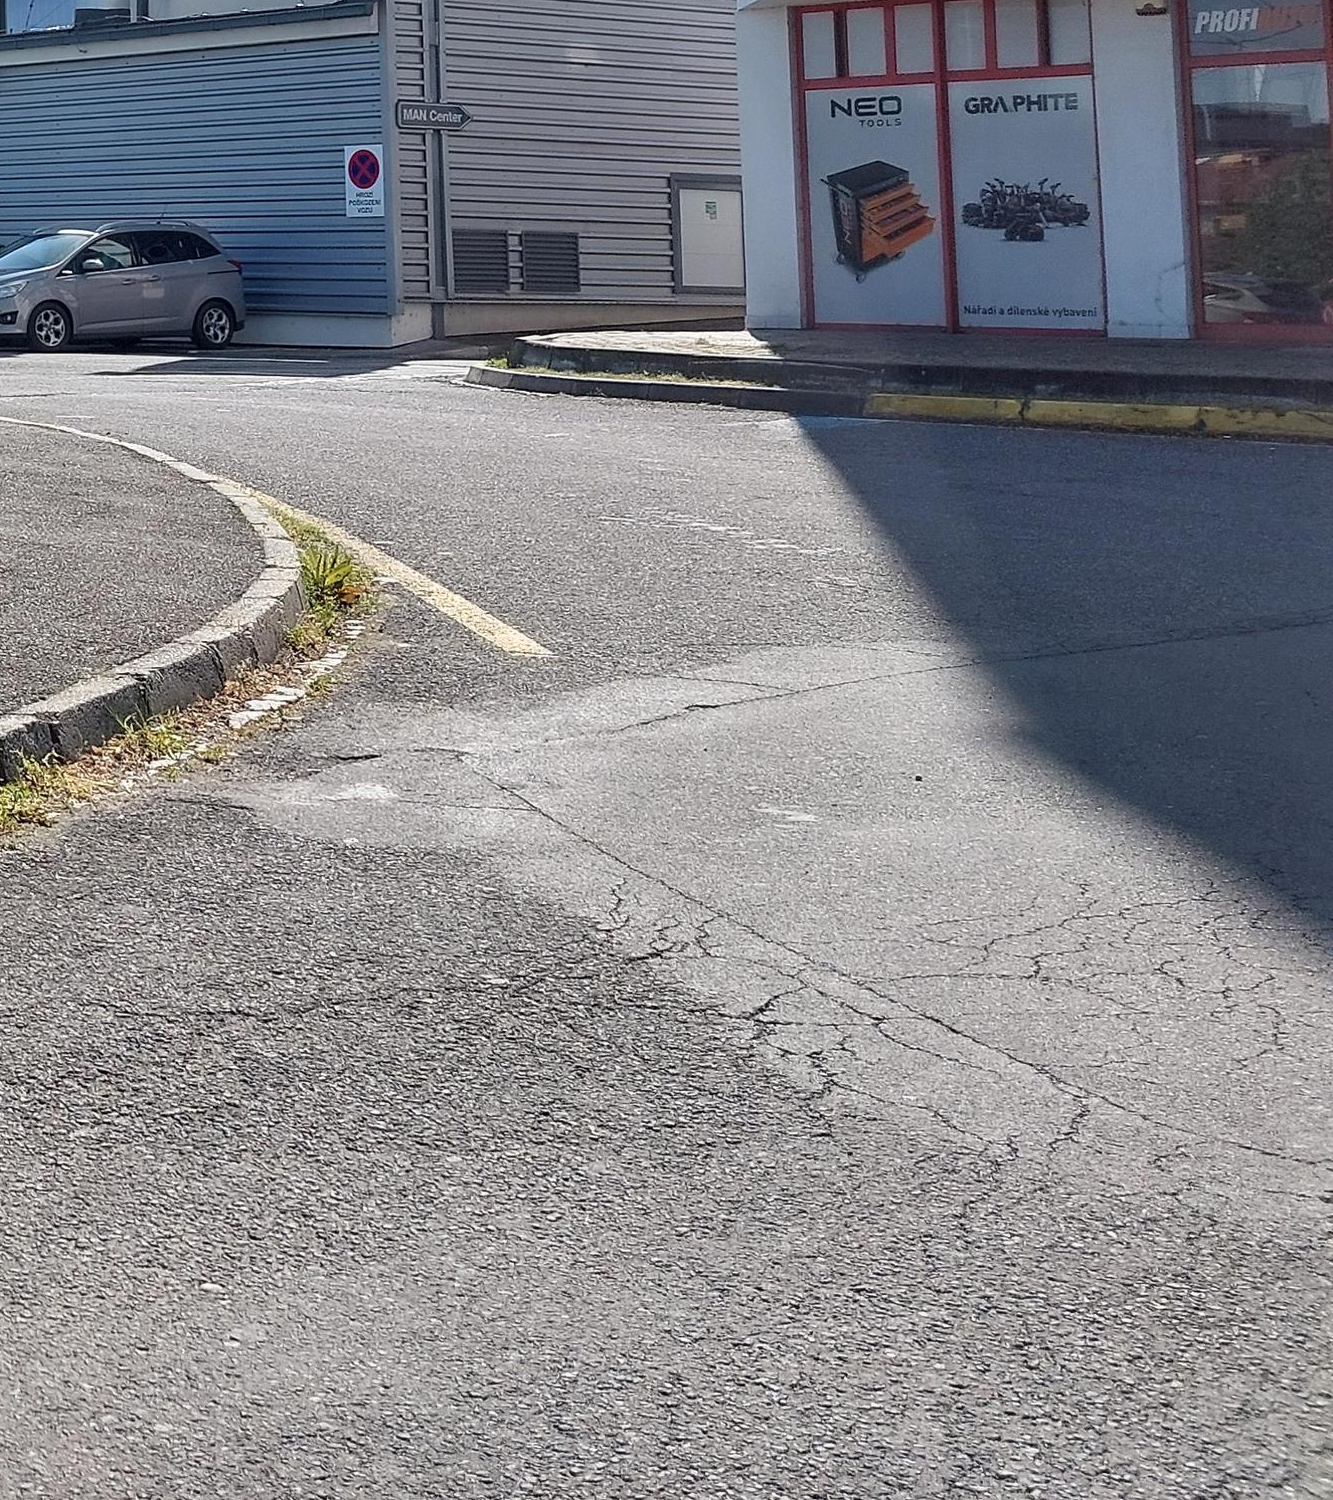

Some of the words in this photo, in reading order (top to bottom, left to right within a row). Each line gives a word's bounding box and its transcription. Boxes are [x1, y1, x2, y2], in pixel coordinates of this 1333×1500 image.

[830, 95, 903, 119] NEO
[964, 92, 1078, 115] GRAPHITE
[402, 108, 428, 121] MAN
[429, 109, 463, 123] Center
[858, 118, 903, 128] TOOLS
[963, 305, 997, 316] Nářadí
[998, 307, 1005, 316] a
[1051, 306, 1098, 318] vybavení
